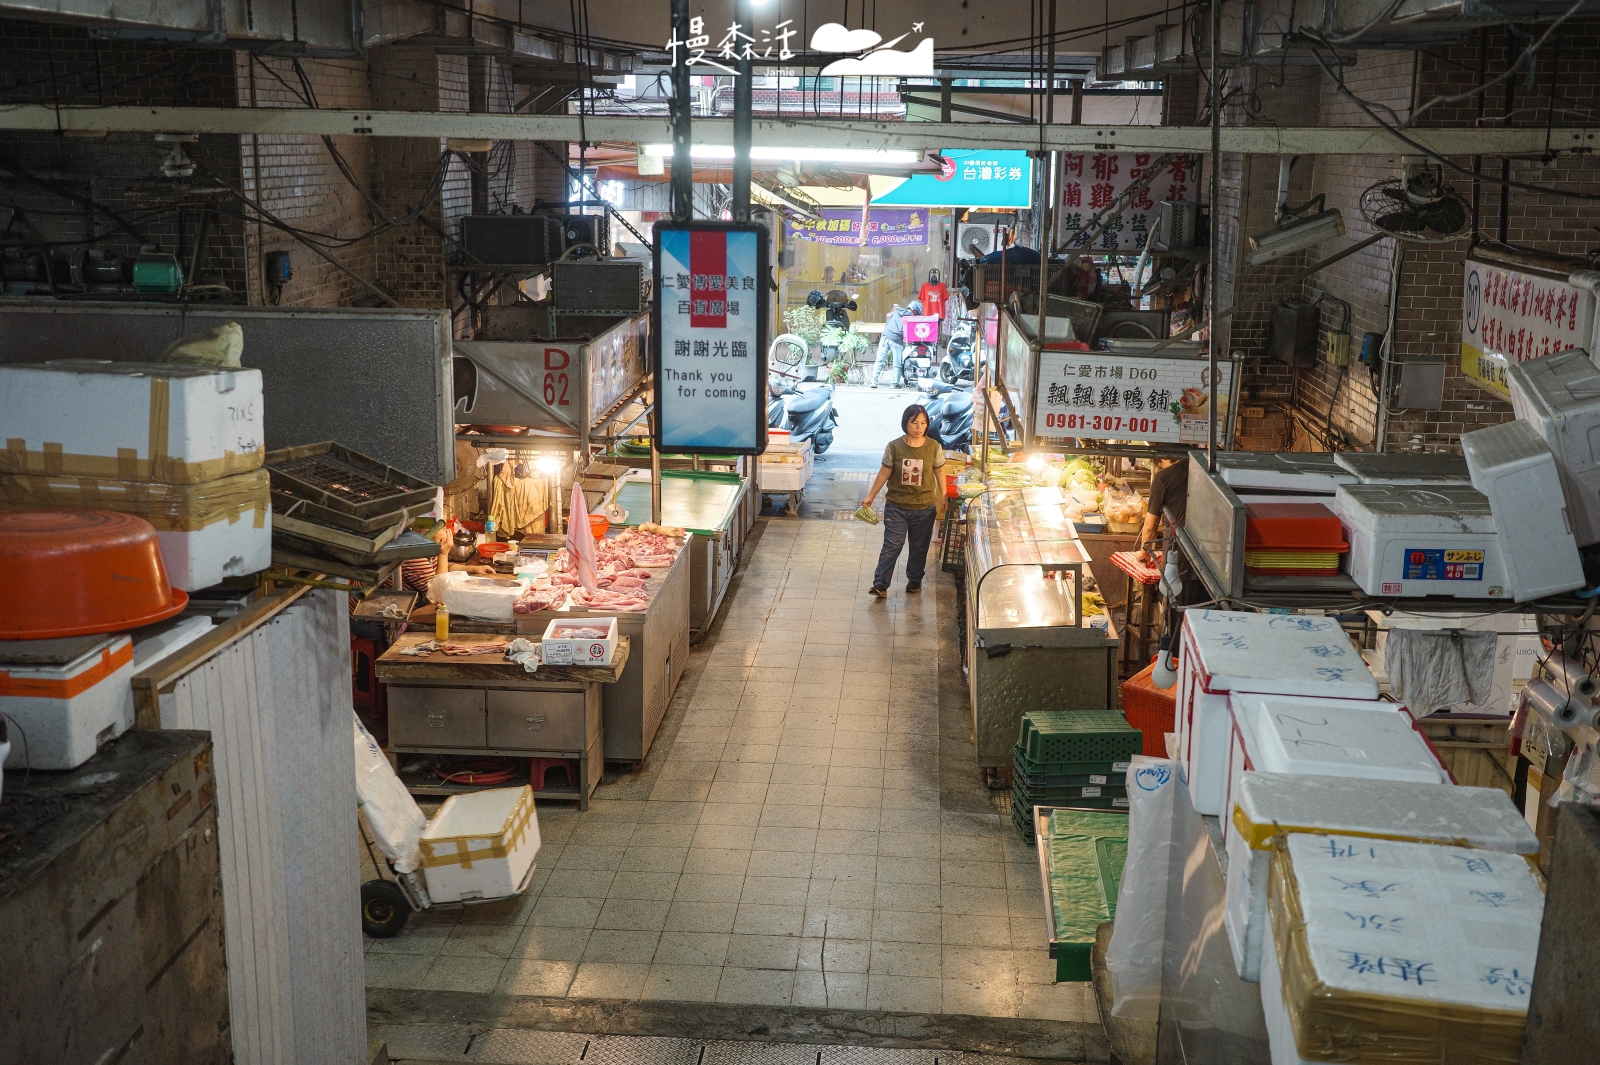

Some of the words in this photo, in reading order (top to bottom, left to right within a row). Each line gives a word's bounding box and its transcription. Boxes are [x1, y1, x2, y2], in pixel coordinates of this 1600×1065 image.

[963, 166, 1023, 180] 台灣彩券
[660, 274, 756, 291] 仁愛博愛美食
[677, 300, 740, 316] 百貨廣場
[674, 340, 748, 358] 謝謝光臨
[544, 348, 570, 371] D
[664, 368, 703, 381] Thank
[710, 371, 733, 383] you
[1062, 364, 1123, 380] 仁愛市場
[1129, 367, 1158, 380] D60
[543, 372, 570, 406] 62
[677, 385, 697, 398] for
[705, 386, 746, 400] coming
[1045, 413, 1158, 433] 0981-307-001
[1446, 552, 1482, 561] サンふじ
